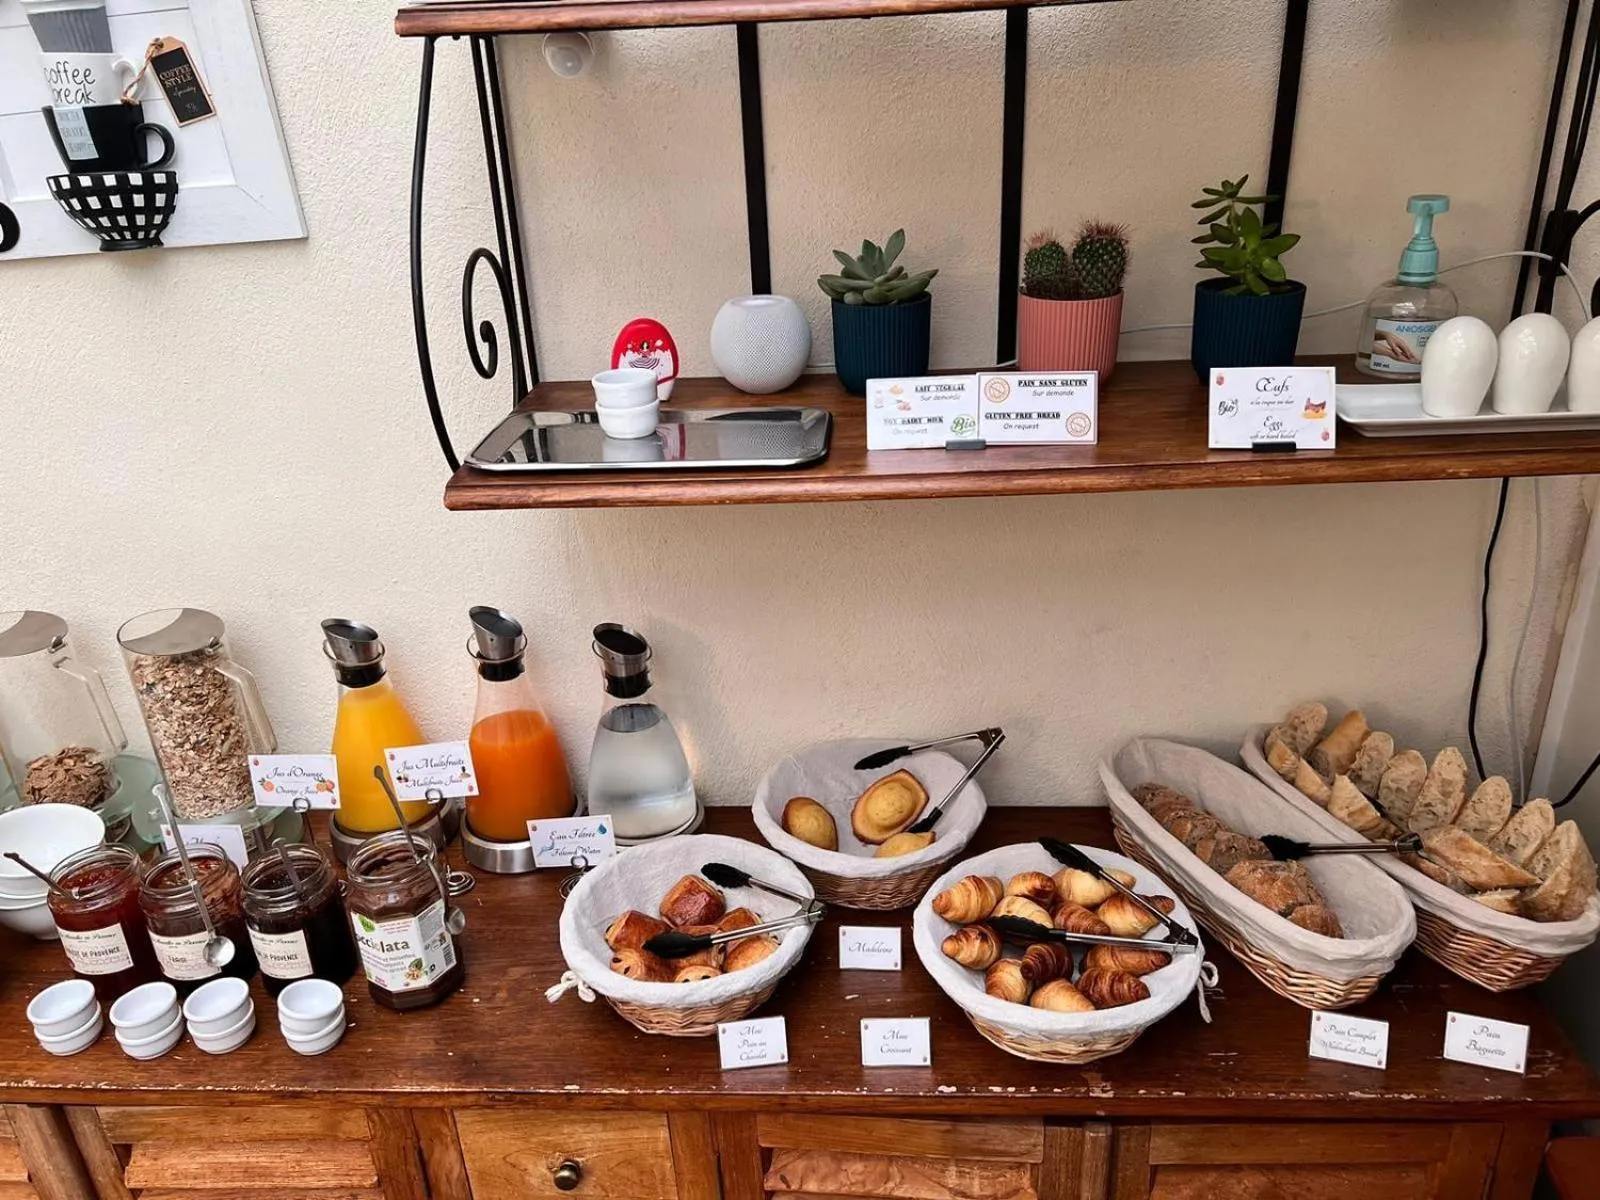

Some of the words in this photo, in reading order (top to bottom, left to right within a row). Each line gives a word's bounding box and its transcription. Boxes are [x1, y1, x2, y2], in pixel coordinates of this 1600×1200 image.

[160, 64, 192, 80] COFFEE
[164, 75, 195, 88] STYLE
[1039, 379, 1057, 387] SANS
[1061, 379, 1088, 387] GLUTEN
[1037, 412, 1061, 420] BREAD
[1015, 423, 1039, 431] request
[89, 945, 121, 958] PROVENCE
[1324, 1024, 1346, 1035] Pain
[1473, 1025, 1500, 1038] Pain
